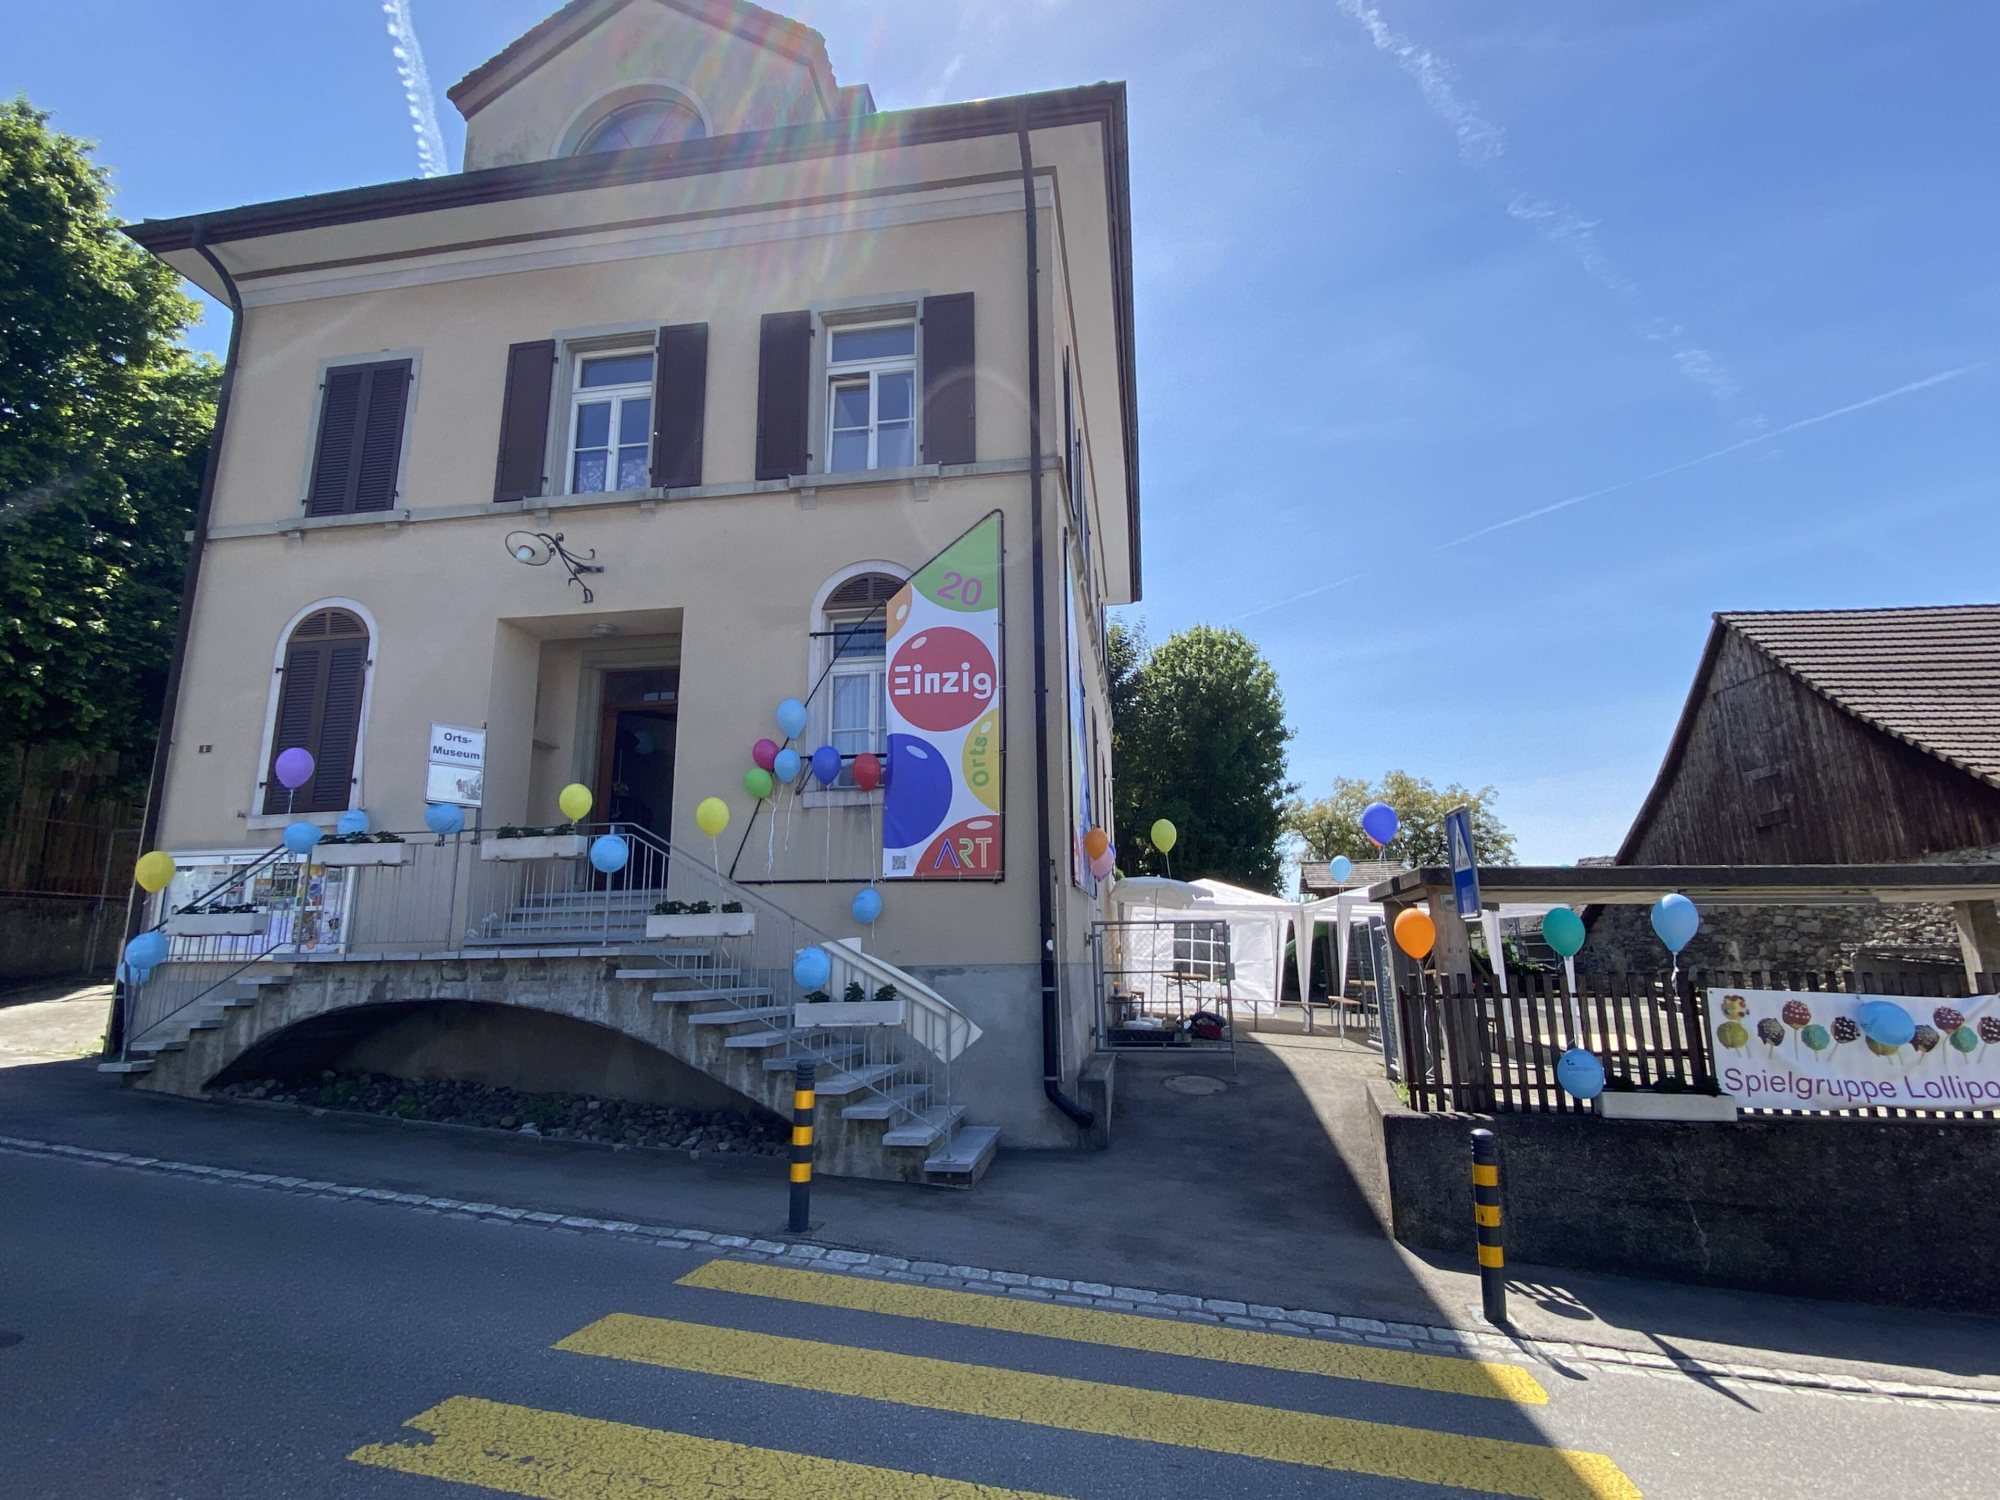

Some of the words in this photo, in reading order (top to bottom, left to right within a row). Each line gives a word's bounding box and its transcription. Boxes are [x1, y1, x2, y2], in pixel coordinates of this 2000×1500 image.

[936, 571, 983, 606] 20
[894, 661, 993, 700] Einzig
[432, 745, 480, 760] Museum
[444, 732, 472, 744] Orts-
[968, 736, 990, 787] Orts
[934, 837, 993, 869] ART
[1723, 1067, 1897, 1103] Spielgruppe
[1904, 1075, 2000, 1105] Lollipo
